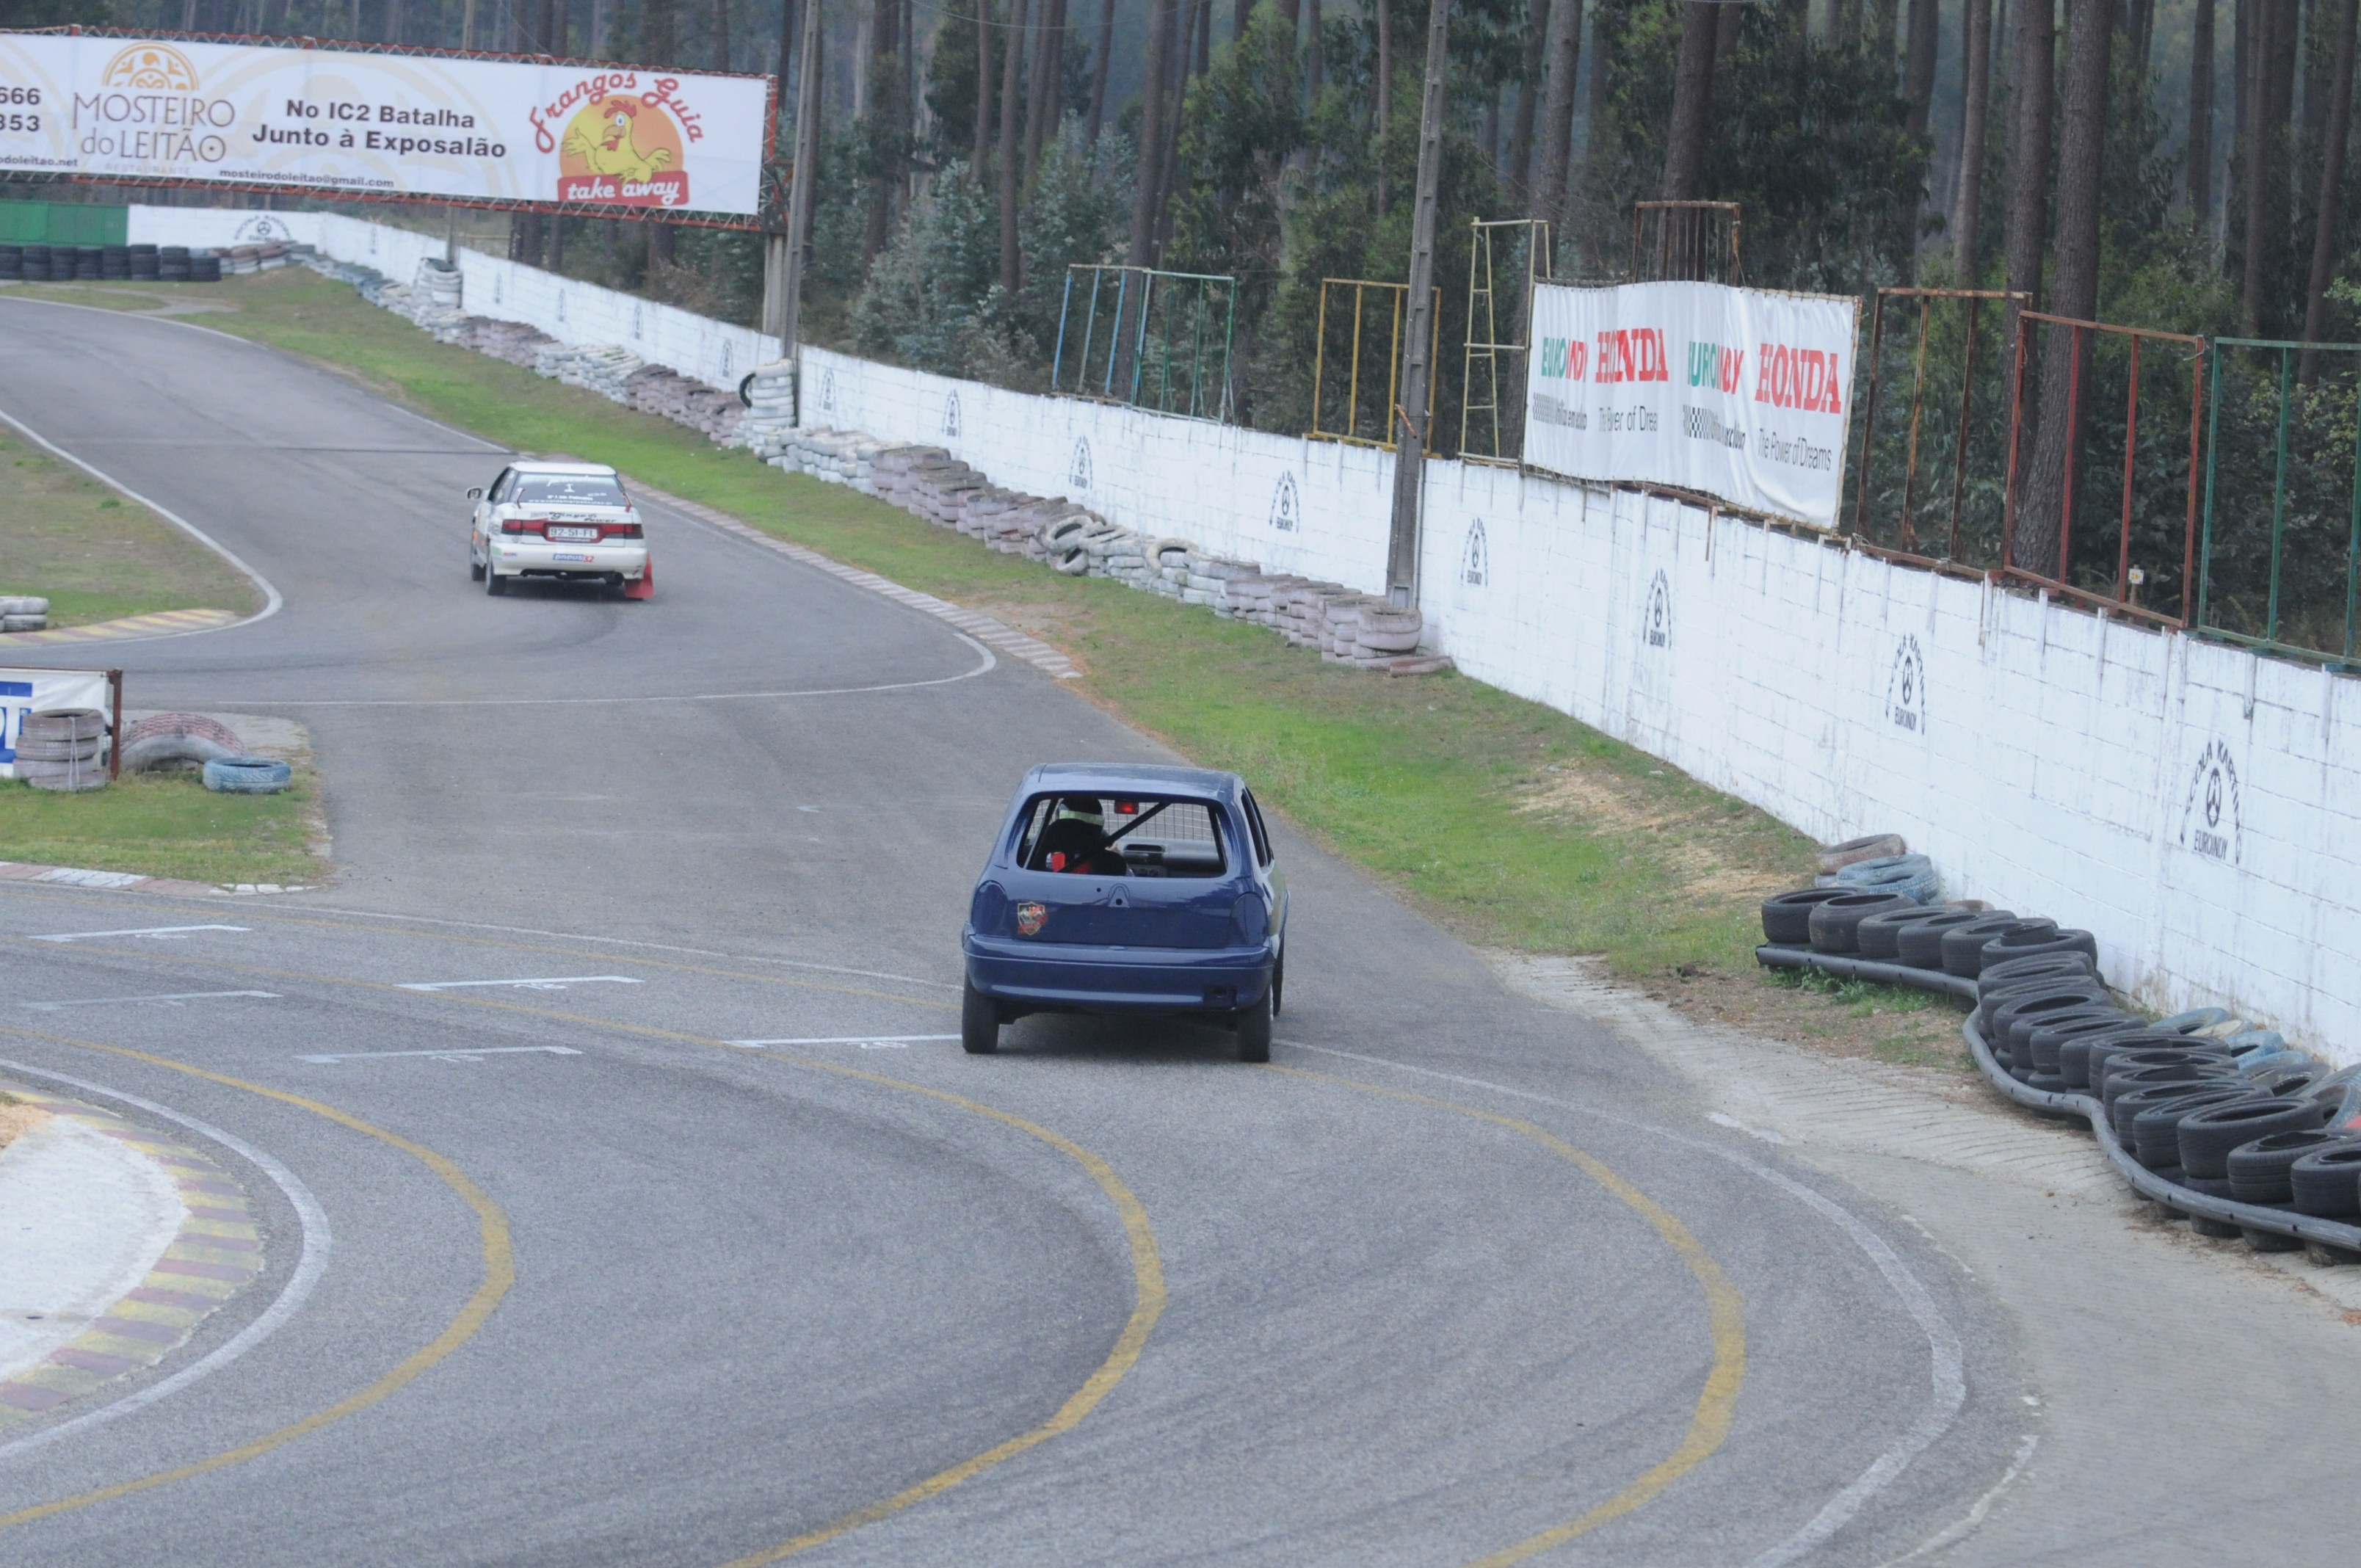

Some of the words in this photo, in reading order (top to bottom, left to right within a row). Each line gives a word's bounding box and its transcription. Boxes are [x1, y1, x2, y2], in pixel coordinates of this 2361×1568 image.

[73, 92, 235, 129] MOSTEIRO
[286, 100, 319, 118] No
[330, 102, 371, 121] IC2
[379, 106, 475, 128] Batalha
[529, 73, 637, 153] Frangos
[81, 128, 115, 155] do
[120, 128, 226, 162] LEITÃO
[253, 125, 329, 146] Junto
[339, 128, 354, 148] à
[366, 131, 507, 158] Exposalão
[220, 169, 394, 187] mosteirodoleitao@gmail.com
[567, 177, 615, 200] take
[622, 181, 679, 206] away
[1596, 328, 1668, 383] HONDA
[1755, 343, 1841, 414] HONDA
[1627, 405, 1636, 431] of
[1639, 405, 1658, 432] Drea
[1800, 437, 1832, 471] Dreams
[2194, 829, 2229, 860] EUROINDY
